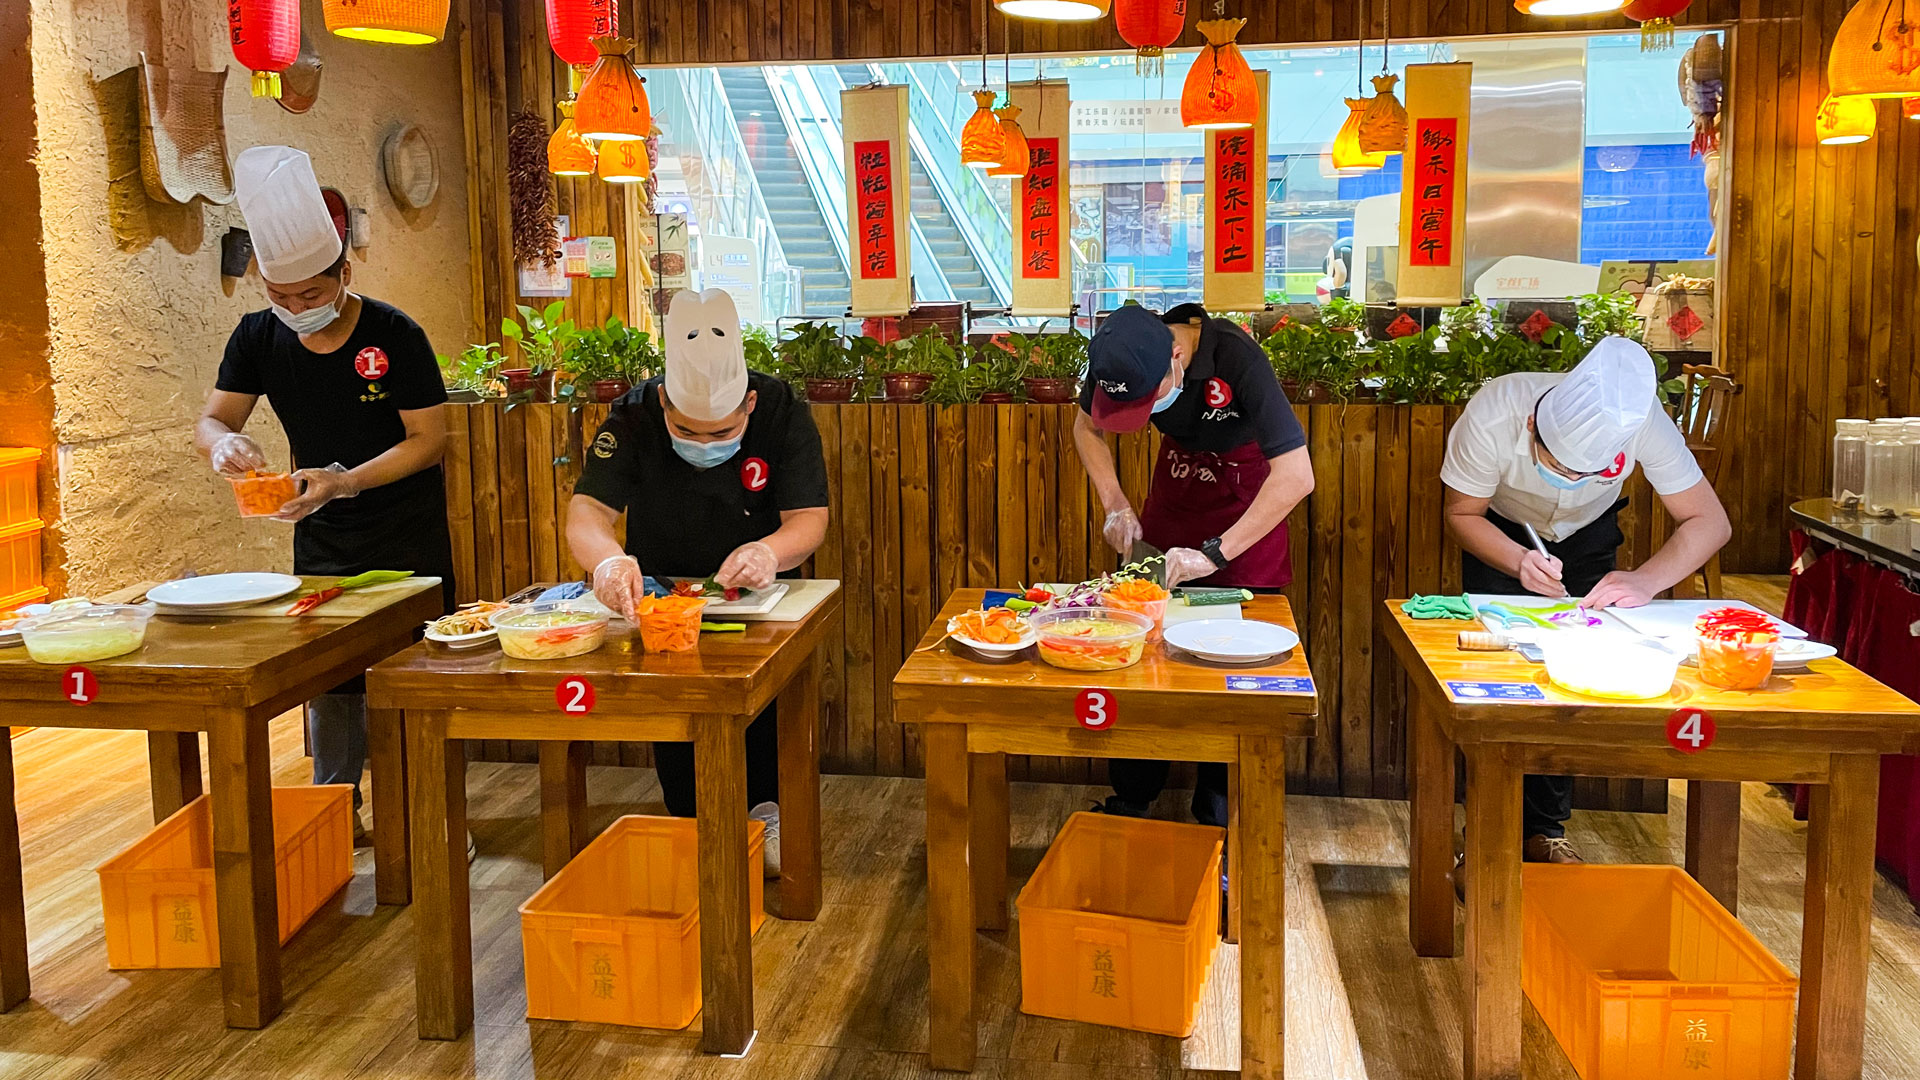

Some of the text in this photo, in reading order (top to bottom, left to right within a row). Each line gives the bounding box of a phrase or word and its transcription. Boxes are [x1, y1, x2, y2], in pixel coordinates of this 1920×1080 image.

[364, 351, 381, 375] 1
[1209, 380, 1225, 404] 3
[746, 462, 767, 488] 2
[70, 672, 88, 702] 1
[566, 681, 586, 712] 2
[1085, 692, 1107, 725] 3
[1676, 713, 1705, 747] 4
[172, 903, 198, 943] 益康
[589, 953, 617, 1000] 益康
[1090, 949, 1118, 998] 益康
[1681, 1018, 1714, 1070] 益康
